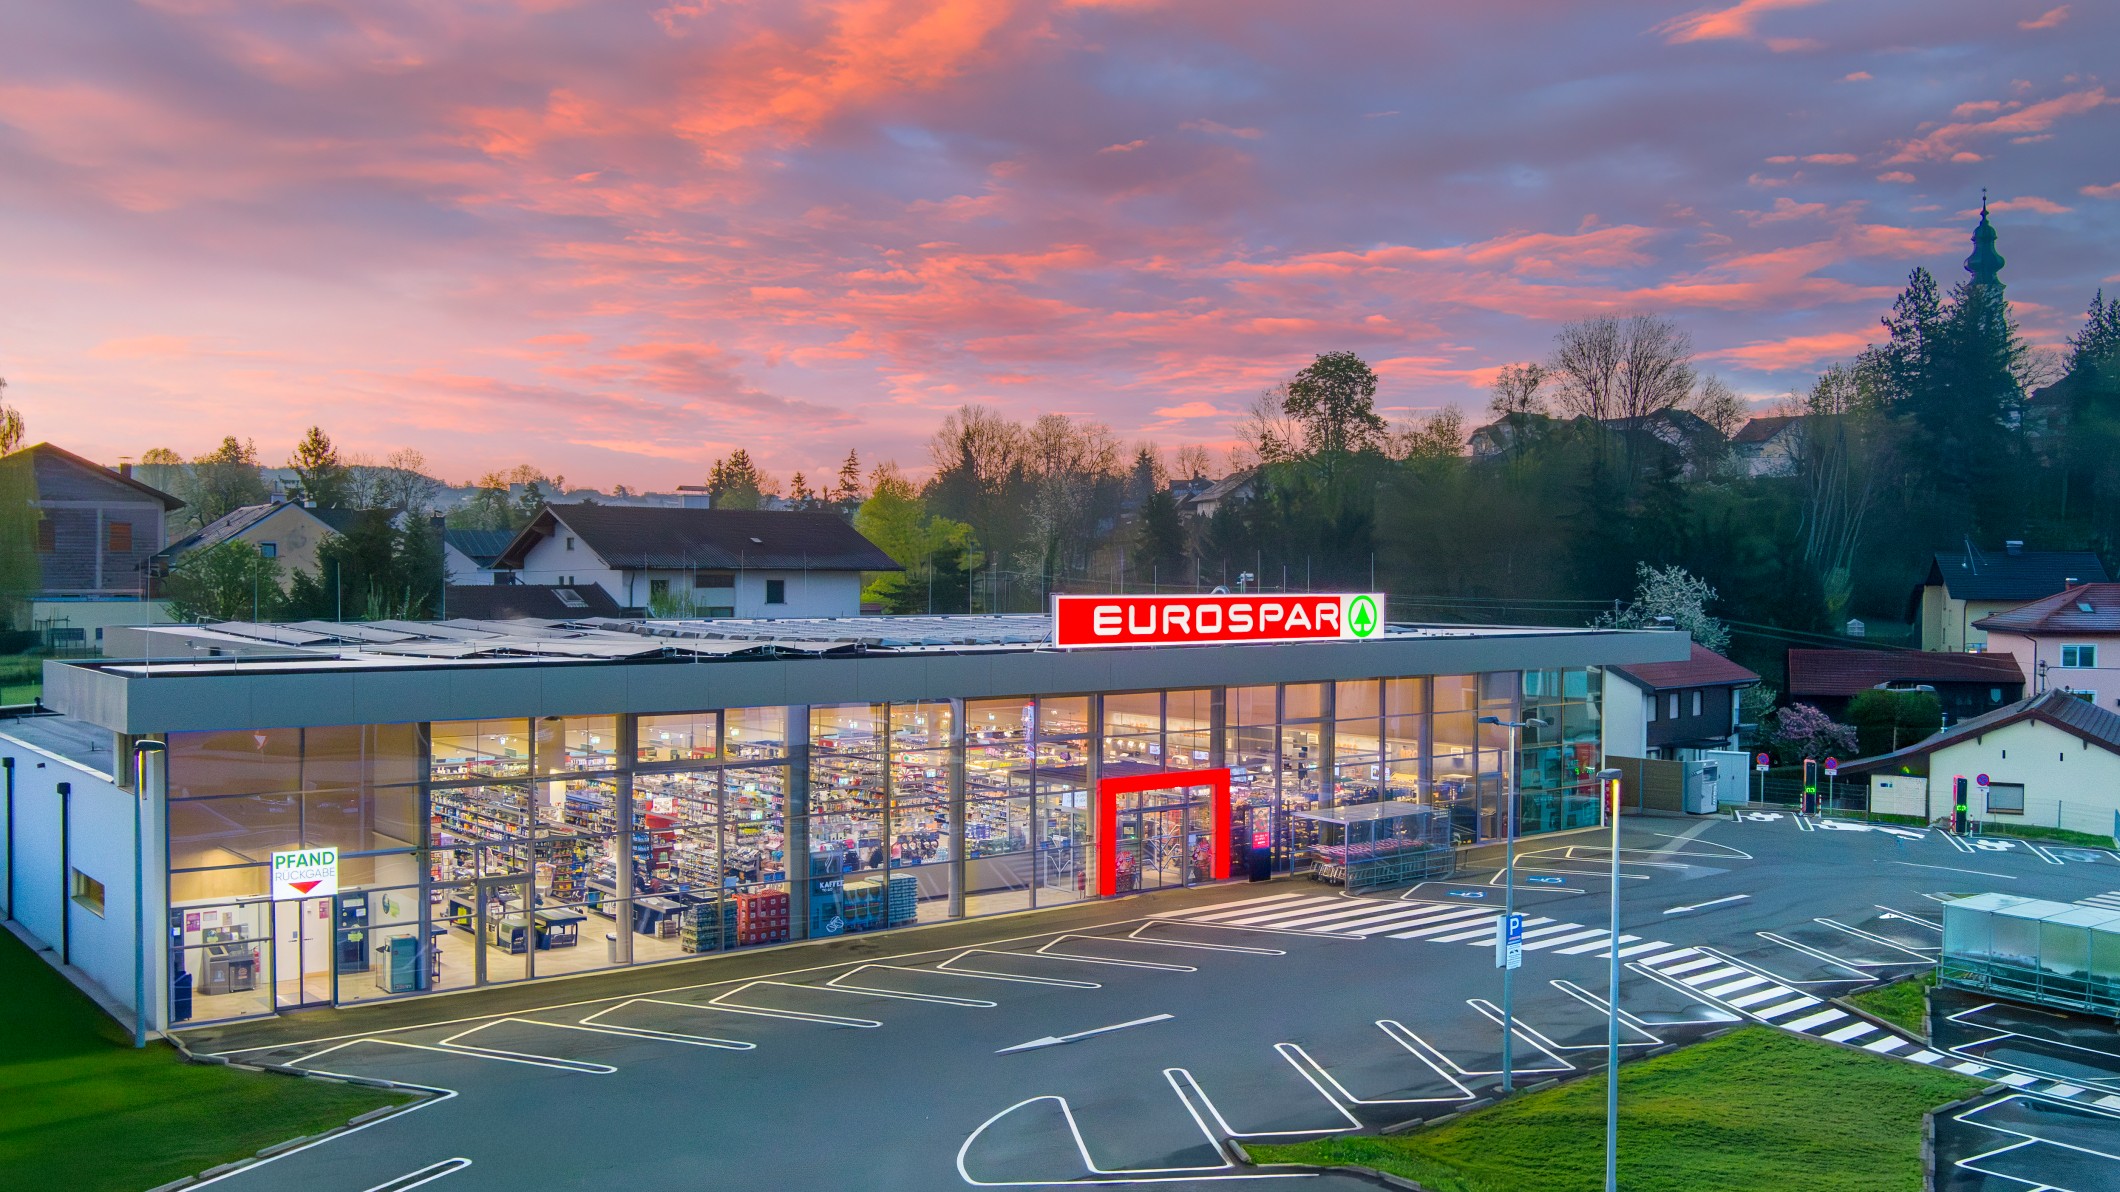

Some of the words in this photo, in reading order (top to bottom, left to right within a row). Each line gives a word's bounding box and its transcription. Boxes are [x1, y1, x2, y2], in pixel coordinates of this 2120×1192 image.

[1093, 603, 1339, 636] EUROSPAR
[275, 851, 335, 869] PFAND
[275, 867, 335, 881] RÜCKGABE
[1510, 917, 1520, 936] P
